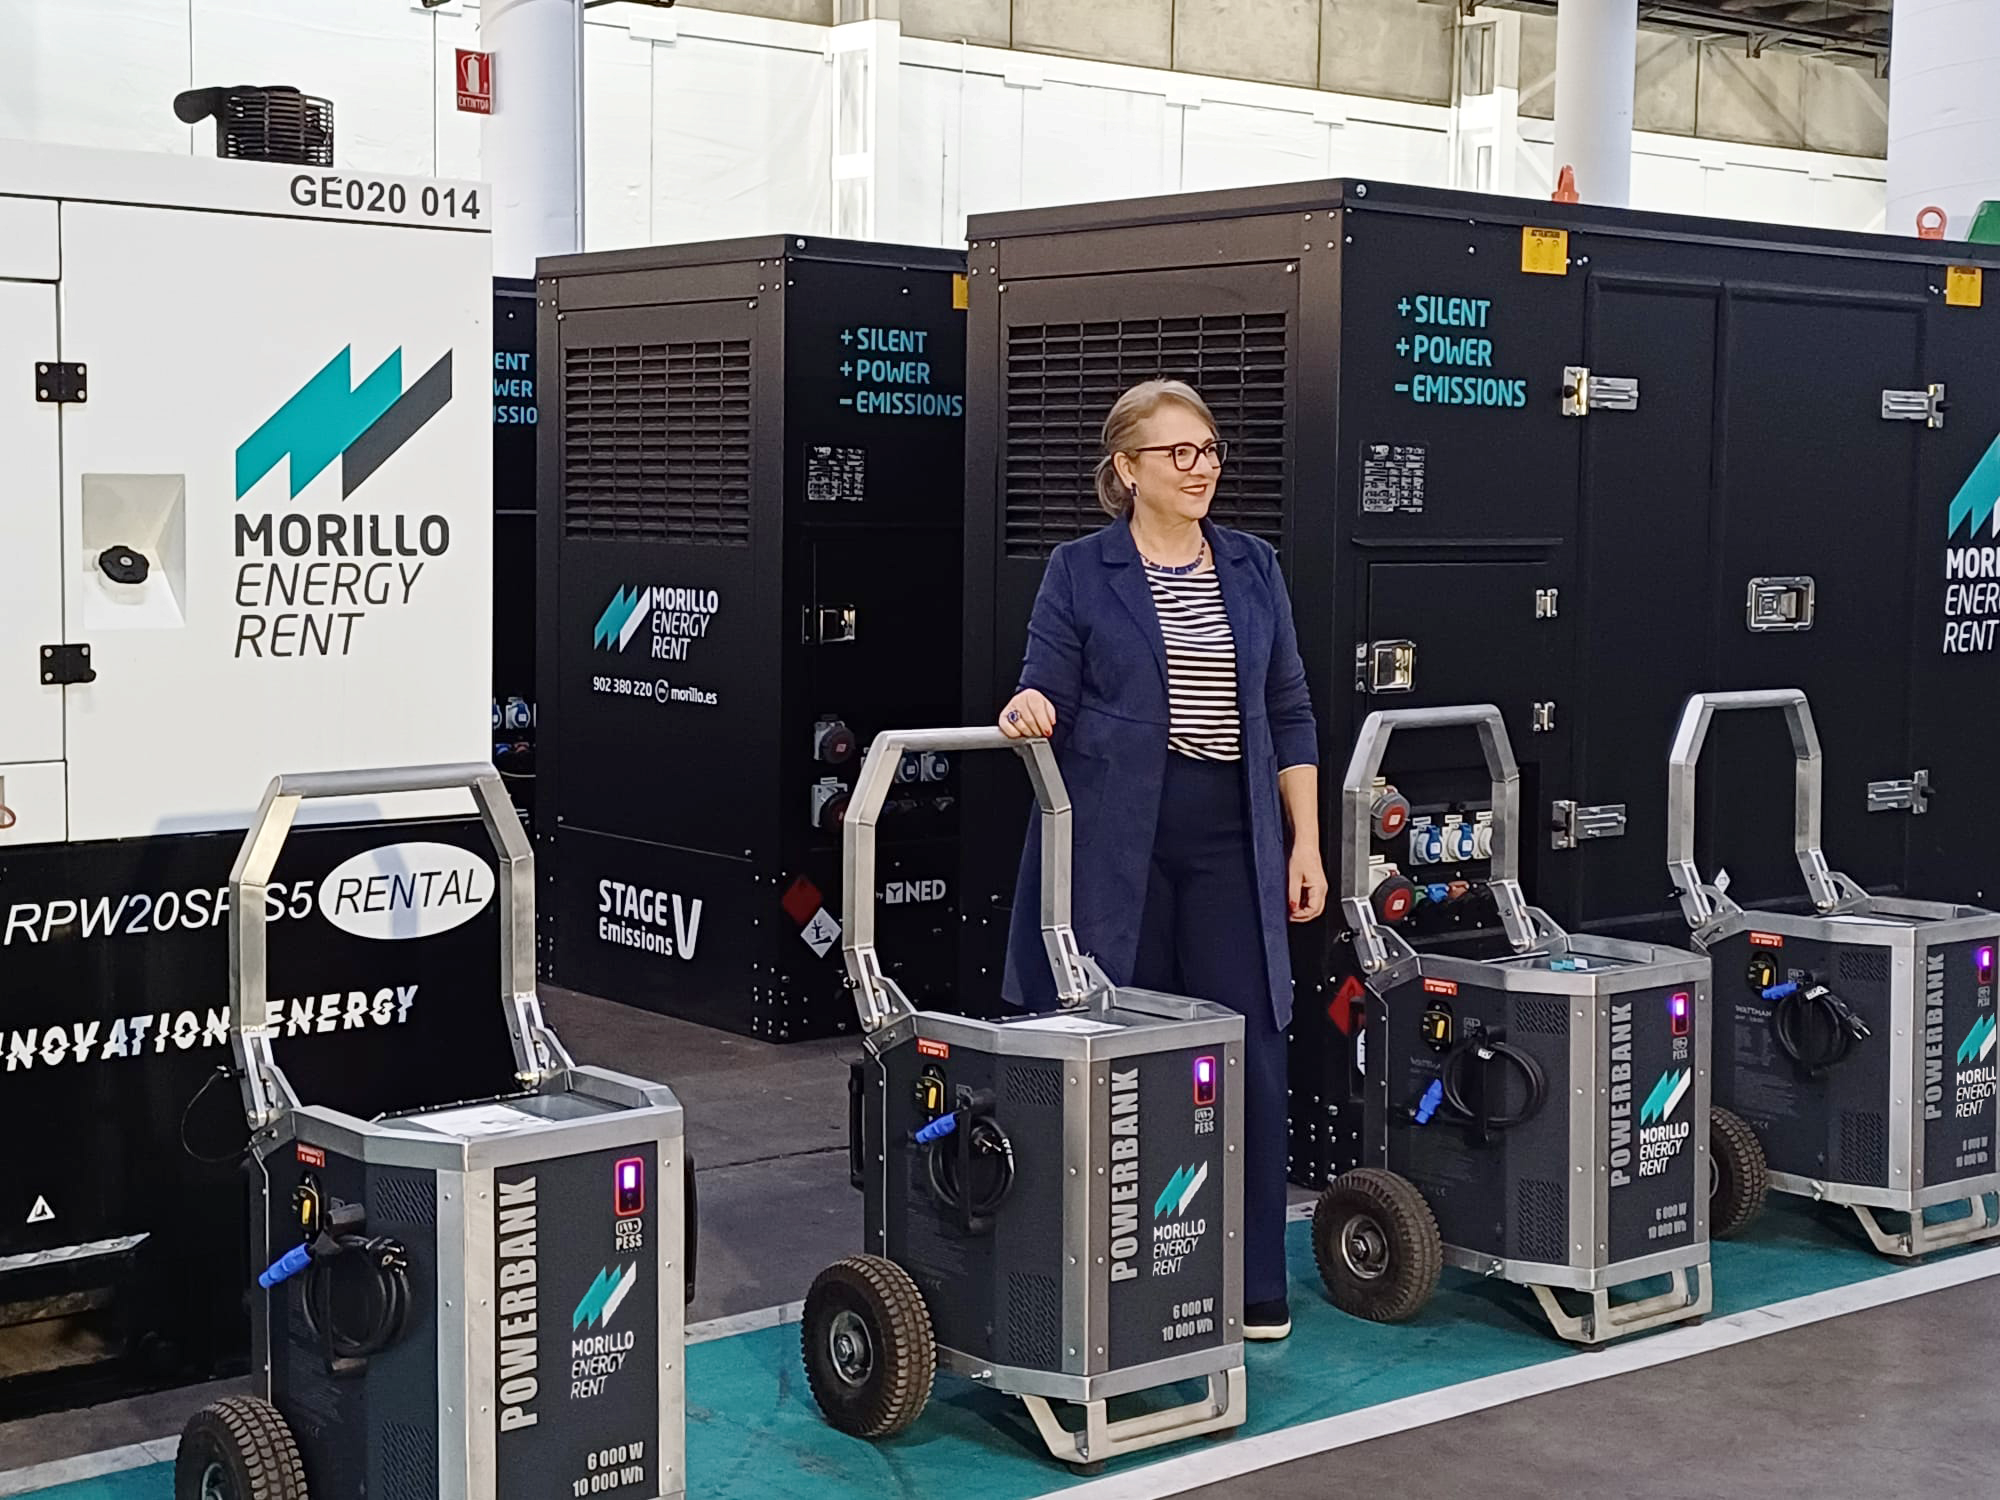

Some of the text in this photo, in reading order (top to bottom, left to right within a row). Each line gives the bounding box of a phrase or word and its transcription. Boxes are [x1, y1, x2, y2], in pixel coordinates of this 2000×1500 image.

[290, 174, 481, 220] GE020 014
[234, 513, 450, 558] MORILLO
[235, 562, 425, 607] ENERGY
[1944, 582, 2000, 616] ENER
[652, 586, 719, 614] MORILLO
[234, 612, 366, 659] RENT
[652, 611, 710, 638] ENERGY
[1942, 619, 2000, 654] RENT
[651, 635, 692, 661] RENT
[593, 676, 612, 692] 902
[633, 681, 652, 697] 220
[670, 686, 718, 705] morillo.es
[334, 868, 484, 916] RENTAL
[599, 879, 703, 961] STAGE V
[599, 916, 674, 956] Emissions
[0, 984, 419, 1072] NOVATION ENERGY
[1924, 953, 1945, 1120] POWERBANK
[1956, 1065, 1997, 1086] MORILL
[1610, 1002, 1633, 1188] POWERBANK
[1955, 1099, 1985, 1118] RENT
[1639, 1121, 1690, 1145] MORILLO
[1639, 1139, 1684, 1161] ENERGY
[1110, 1068, 1139, 1283] POWERBANK
[1638, 1156, 1670, 1177] RENT
[615, 1233, 643, 1251] PESS
[1153, 1218, 1207, 1242] MORILLO
[1153, 1237, 1199, 1260] ENERGY
[1152, 1256, 1185, 1277] RENT
[498, 1175, 539, 1433] POWERBANK
[1172, 1297, 1214, 1321] 6 000 W
[571, 1330, 635, 1359] MORILLO
[1161, 1325, 1174, 1342] 10
[1174, 1320, 1196, 1340] 000
[571, 1351, 626, 1380] ENERGY
[570, 1375, 609, 1400] RENT
[587, 1440, 644, 1471] 6 000 W
[572, 1465, 645, 1498] 10 000 Wh
